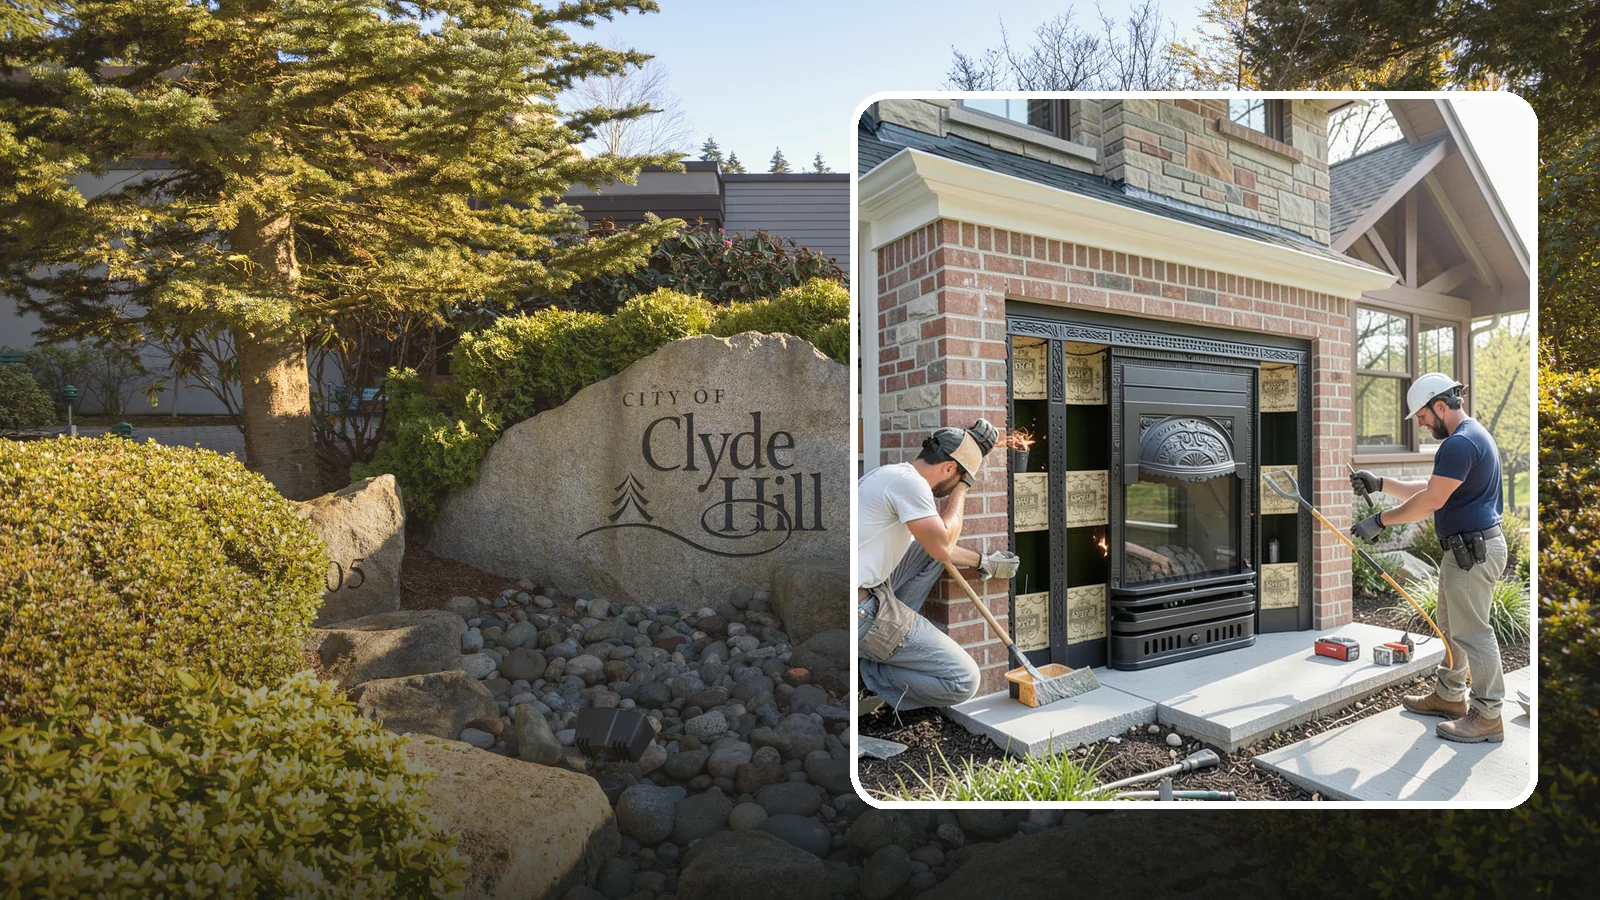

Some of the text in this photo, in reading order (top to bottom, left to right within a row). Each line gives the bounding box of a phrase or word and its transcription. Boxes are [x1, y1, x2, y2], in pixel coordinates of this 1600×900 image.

[622, 388, 726, 407] CITY OF
[641, 410, 796, 493] Clyde
[717, 472, 828, 532] Hill
